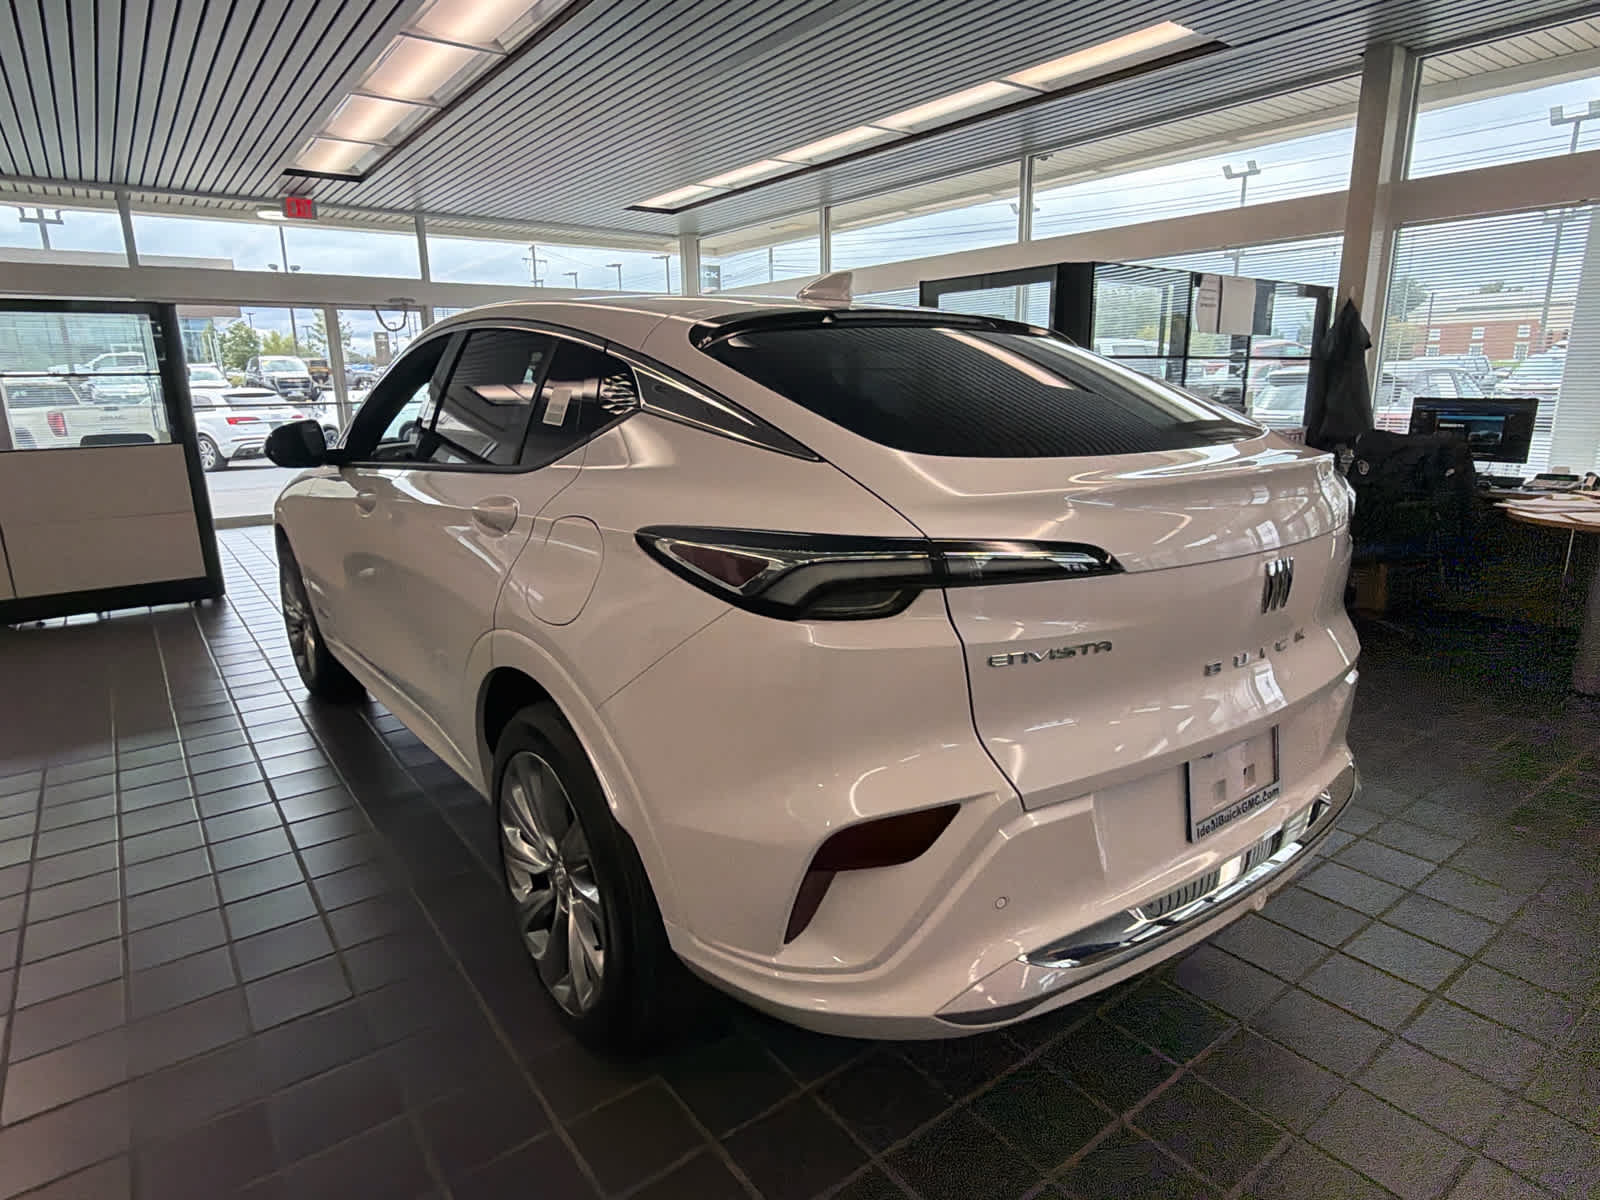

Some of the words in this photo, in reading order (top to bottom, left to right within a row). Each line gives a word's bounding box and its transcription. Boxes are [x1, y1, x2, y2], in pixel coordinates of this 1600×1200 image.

[286, 199, 312, 217] EXIT
[987, 641, 1112, 667] ENVISTA
[1203, 628, 1305, 676] BUICK
